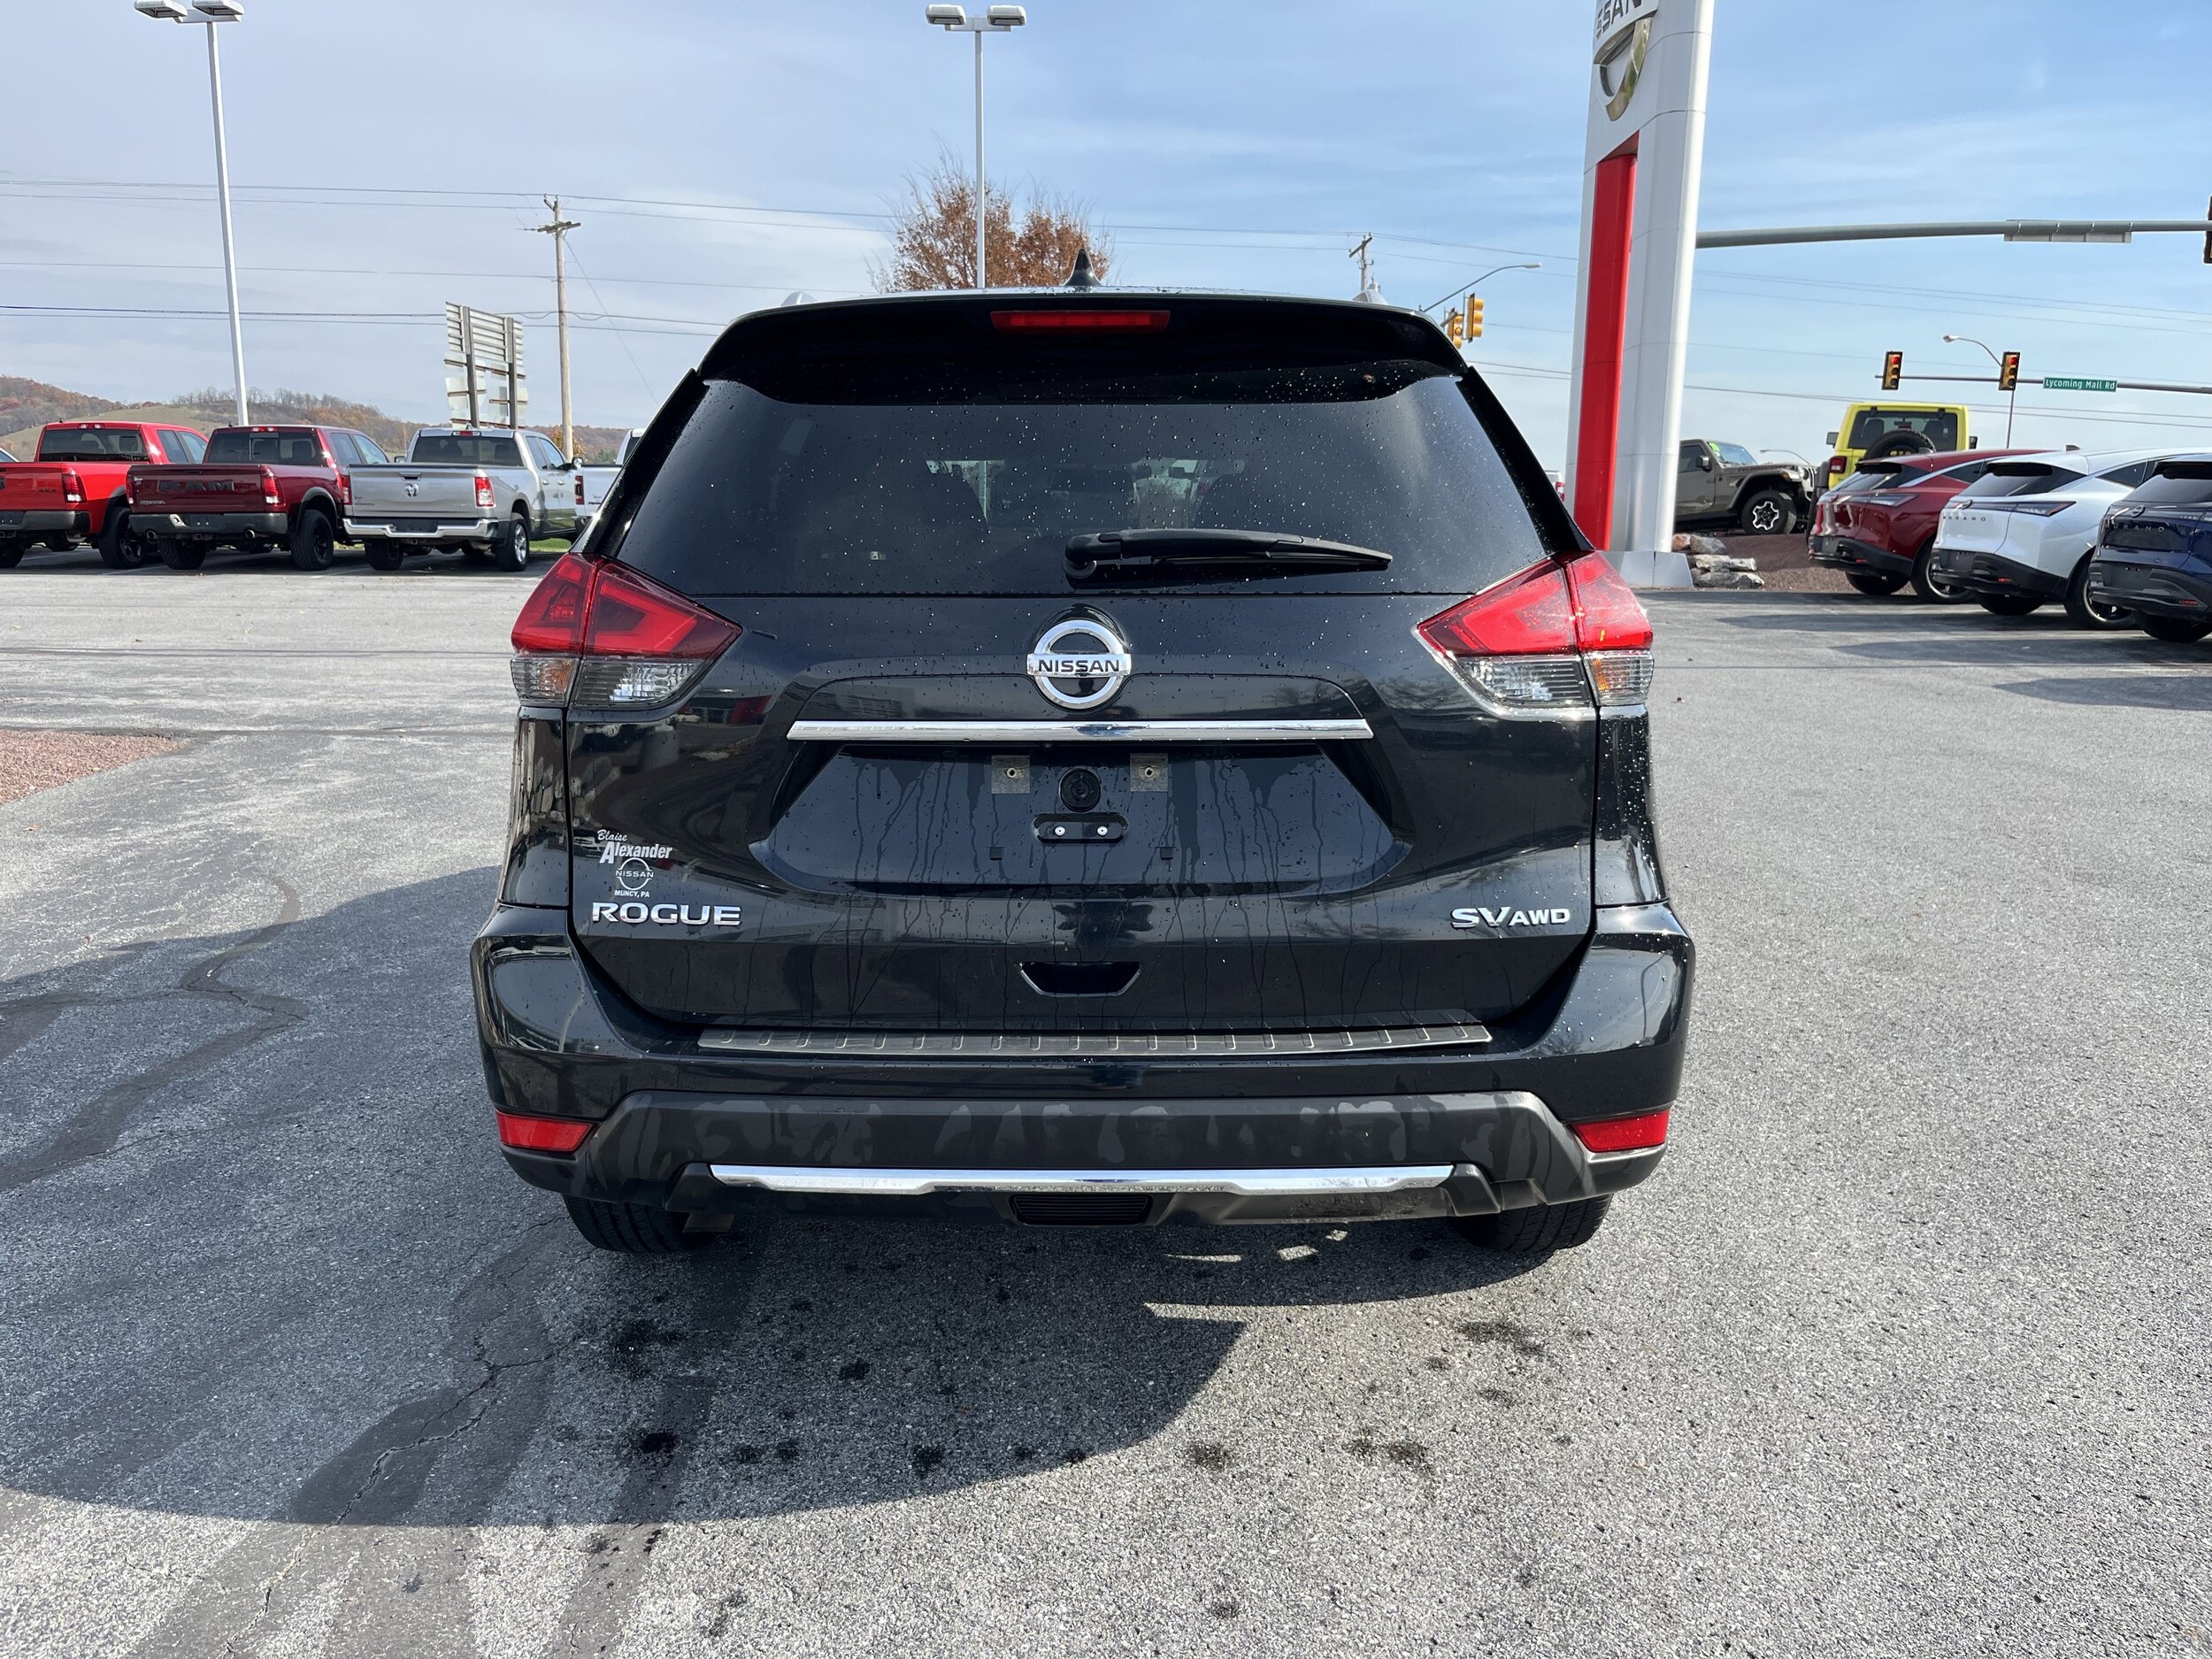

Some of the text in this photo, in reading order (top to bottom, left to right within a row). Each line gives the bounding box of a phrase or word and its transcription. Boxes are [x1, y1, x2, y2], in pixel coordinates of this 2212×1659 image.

[2046, 380, 2082, 389] Lycoming
[2085, 380, 2101, 389] Mall
[158, 480, 234, 492] RAM
[1038, 659, 1120, 672] NISSAN
[597, 829, 628, 841] Blaise
[599, 841, 672, 864] Alexander
[592, 902, 742, 926] ROGUE
